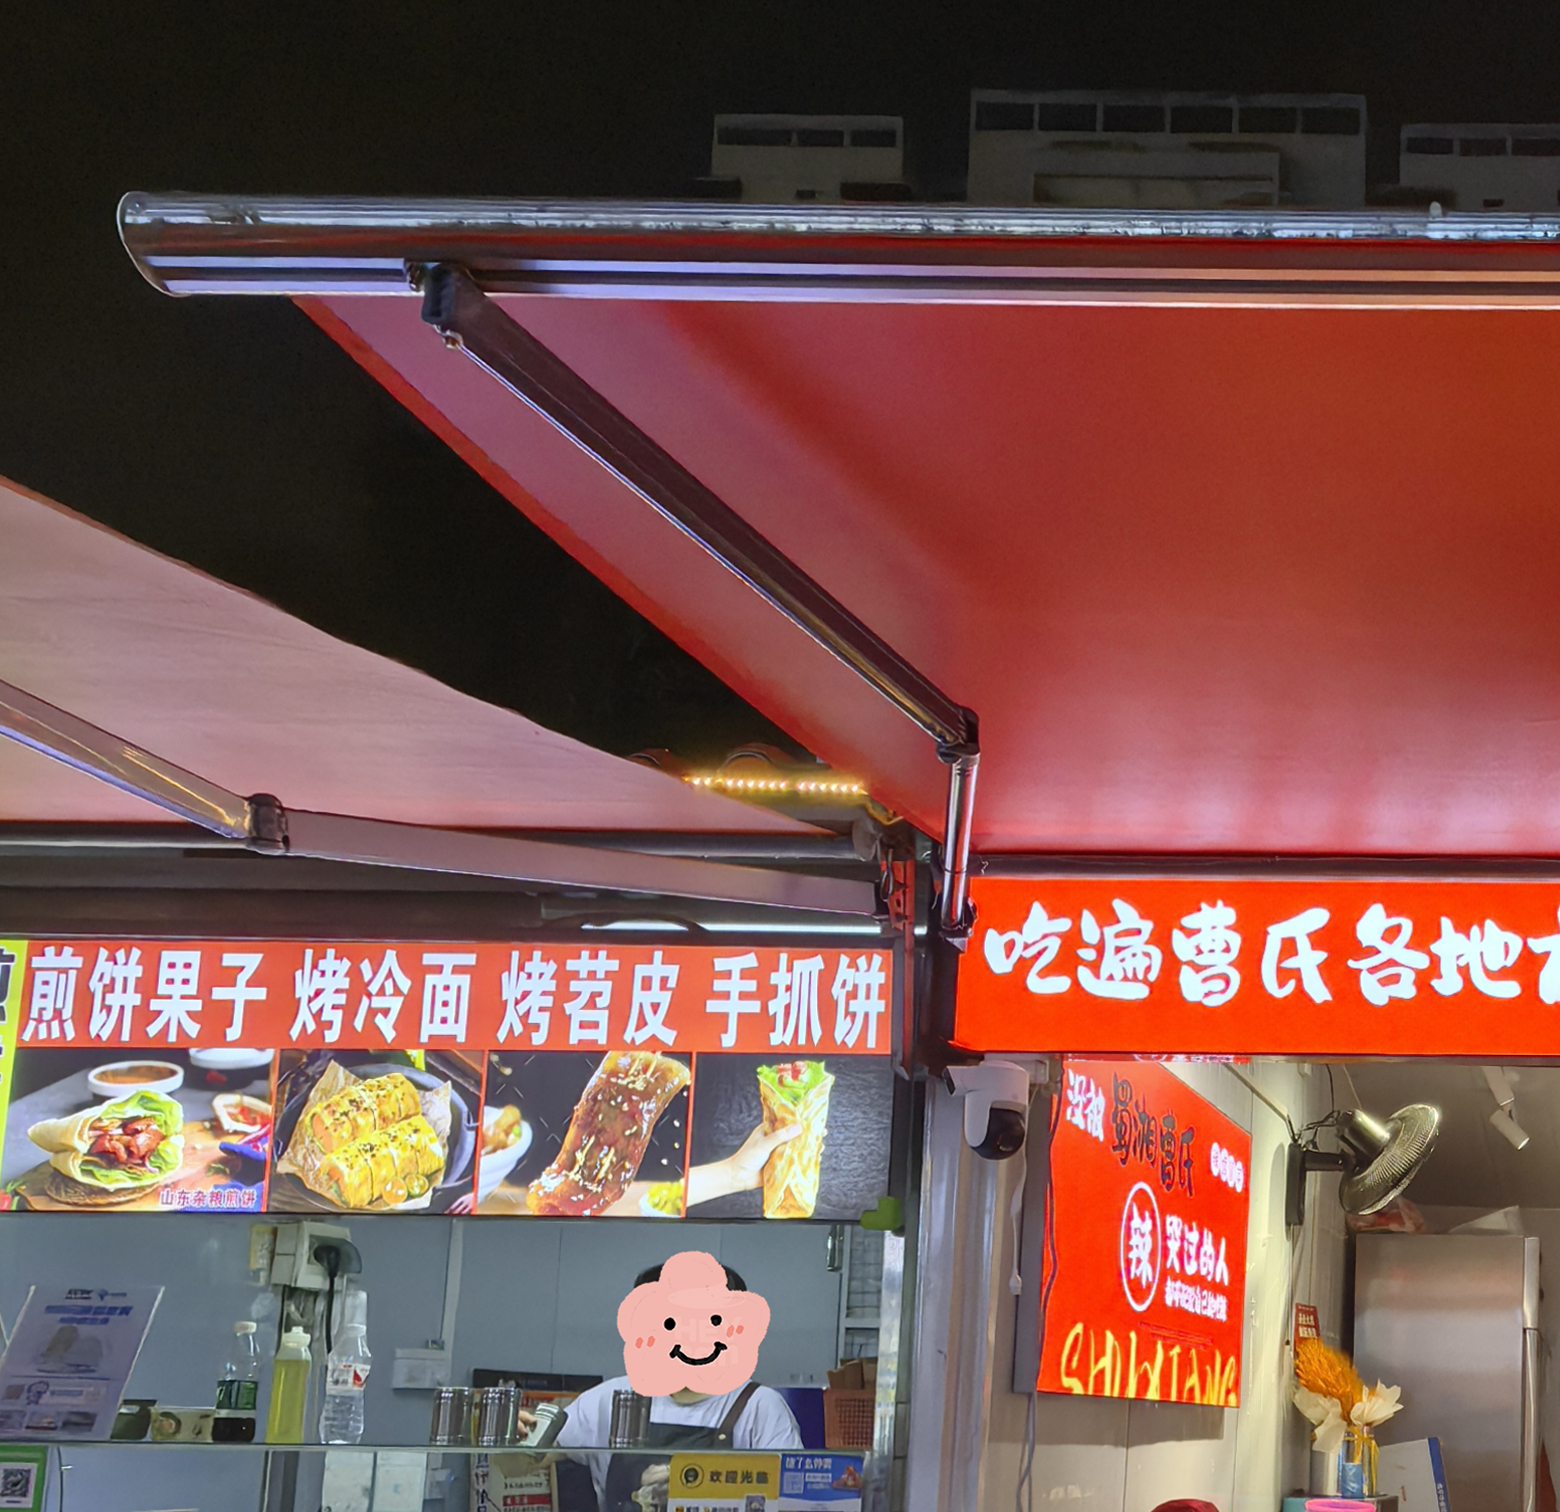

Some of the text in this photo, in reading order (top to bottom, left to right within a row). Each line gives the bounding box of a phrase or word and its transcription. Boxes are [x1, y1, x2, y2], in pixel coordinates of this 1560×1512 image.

[21, 946, 268, 1043] 煎饼果子
[290, 949, 478, 1044] 烤冷面
[706, 952, 886, 1048] 手抓饼
